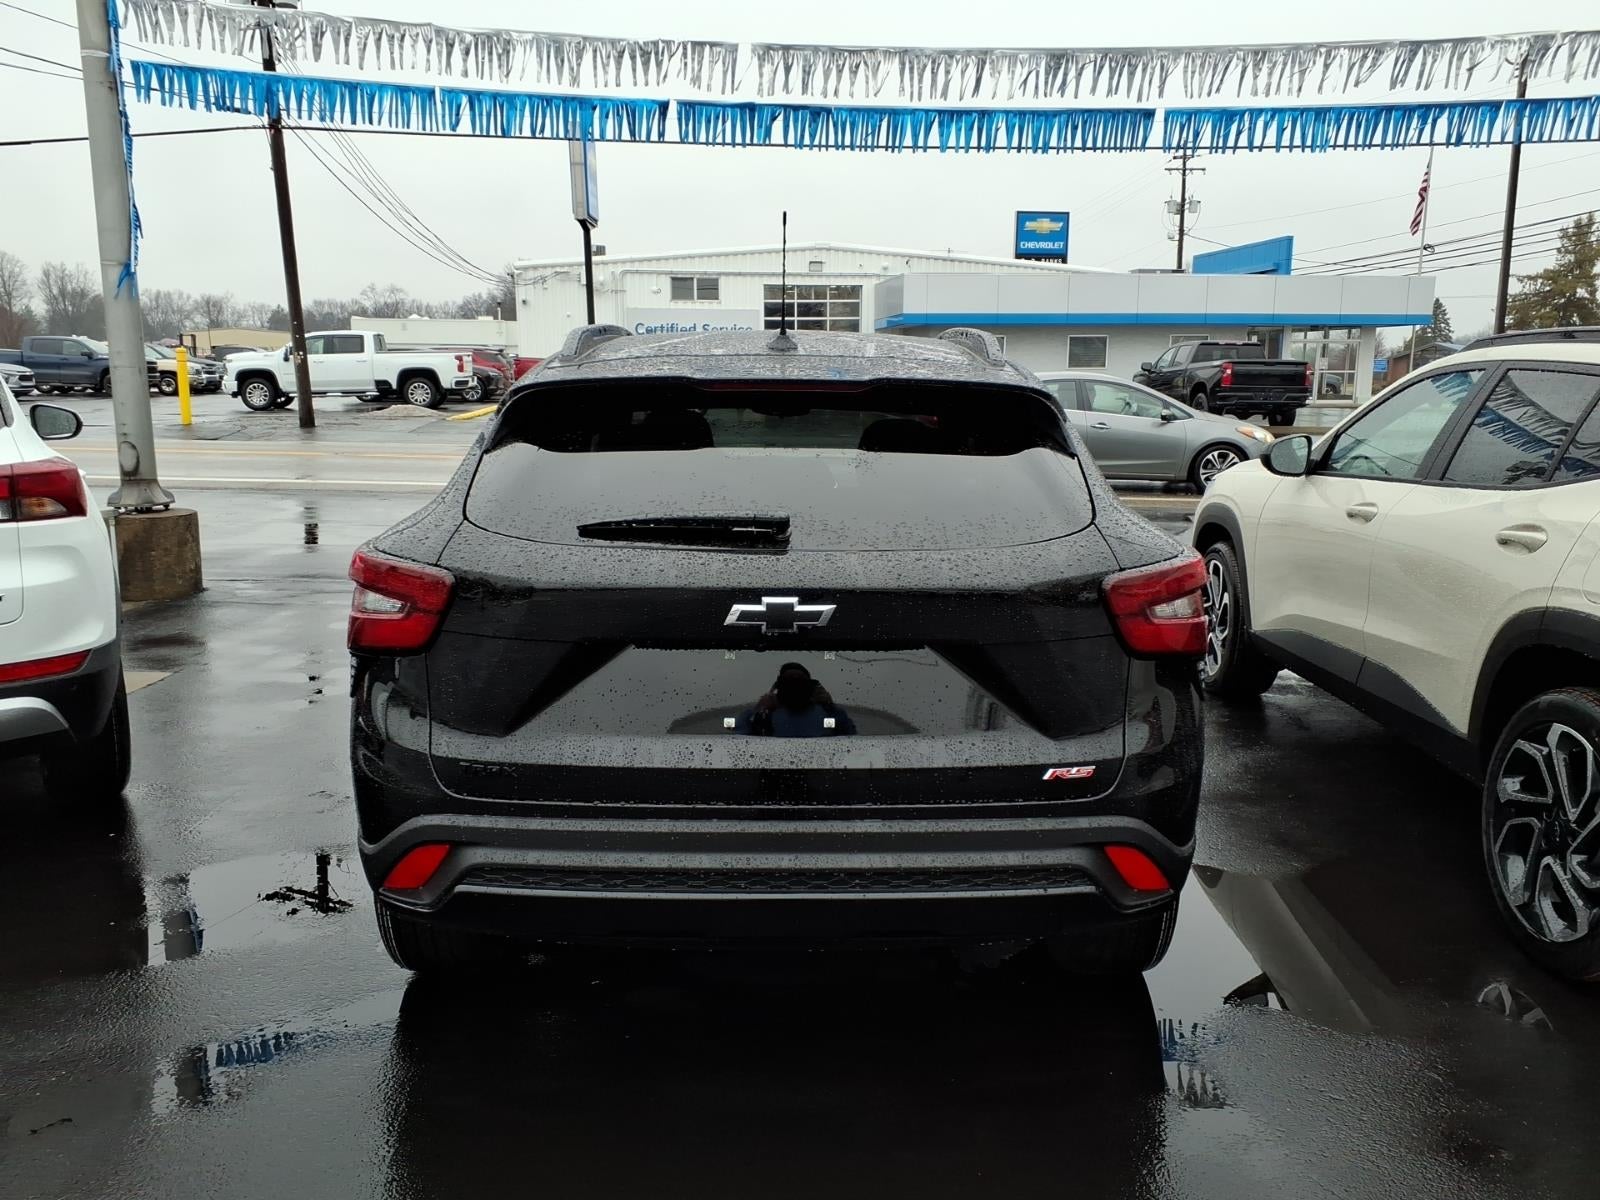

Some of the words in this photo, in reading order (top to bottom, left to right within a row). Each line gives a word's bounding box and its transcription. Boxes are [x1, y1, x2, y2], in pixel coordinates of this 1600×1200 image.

[1020, 241, 1064, 249] CHEVROLET
[635, 322, 697, 335] Certified
[1042, 765, 1096, 780] RS
